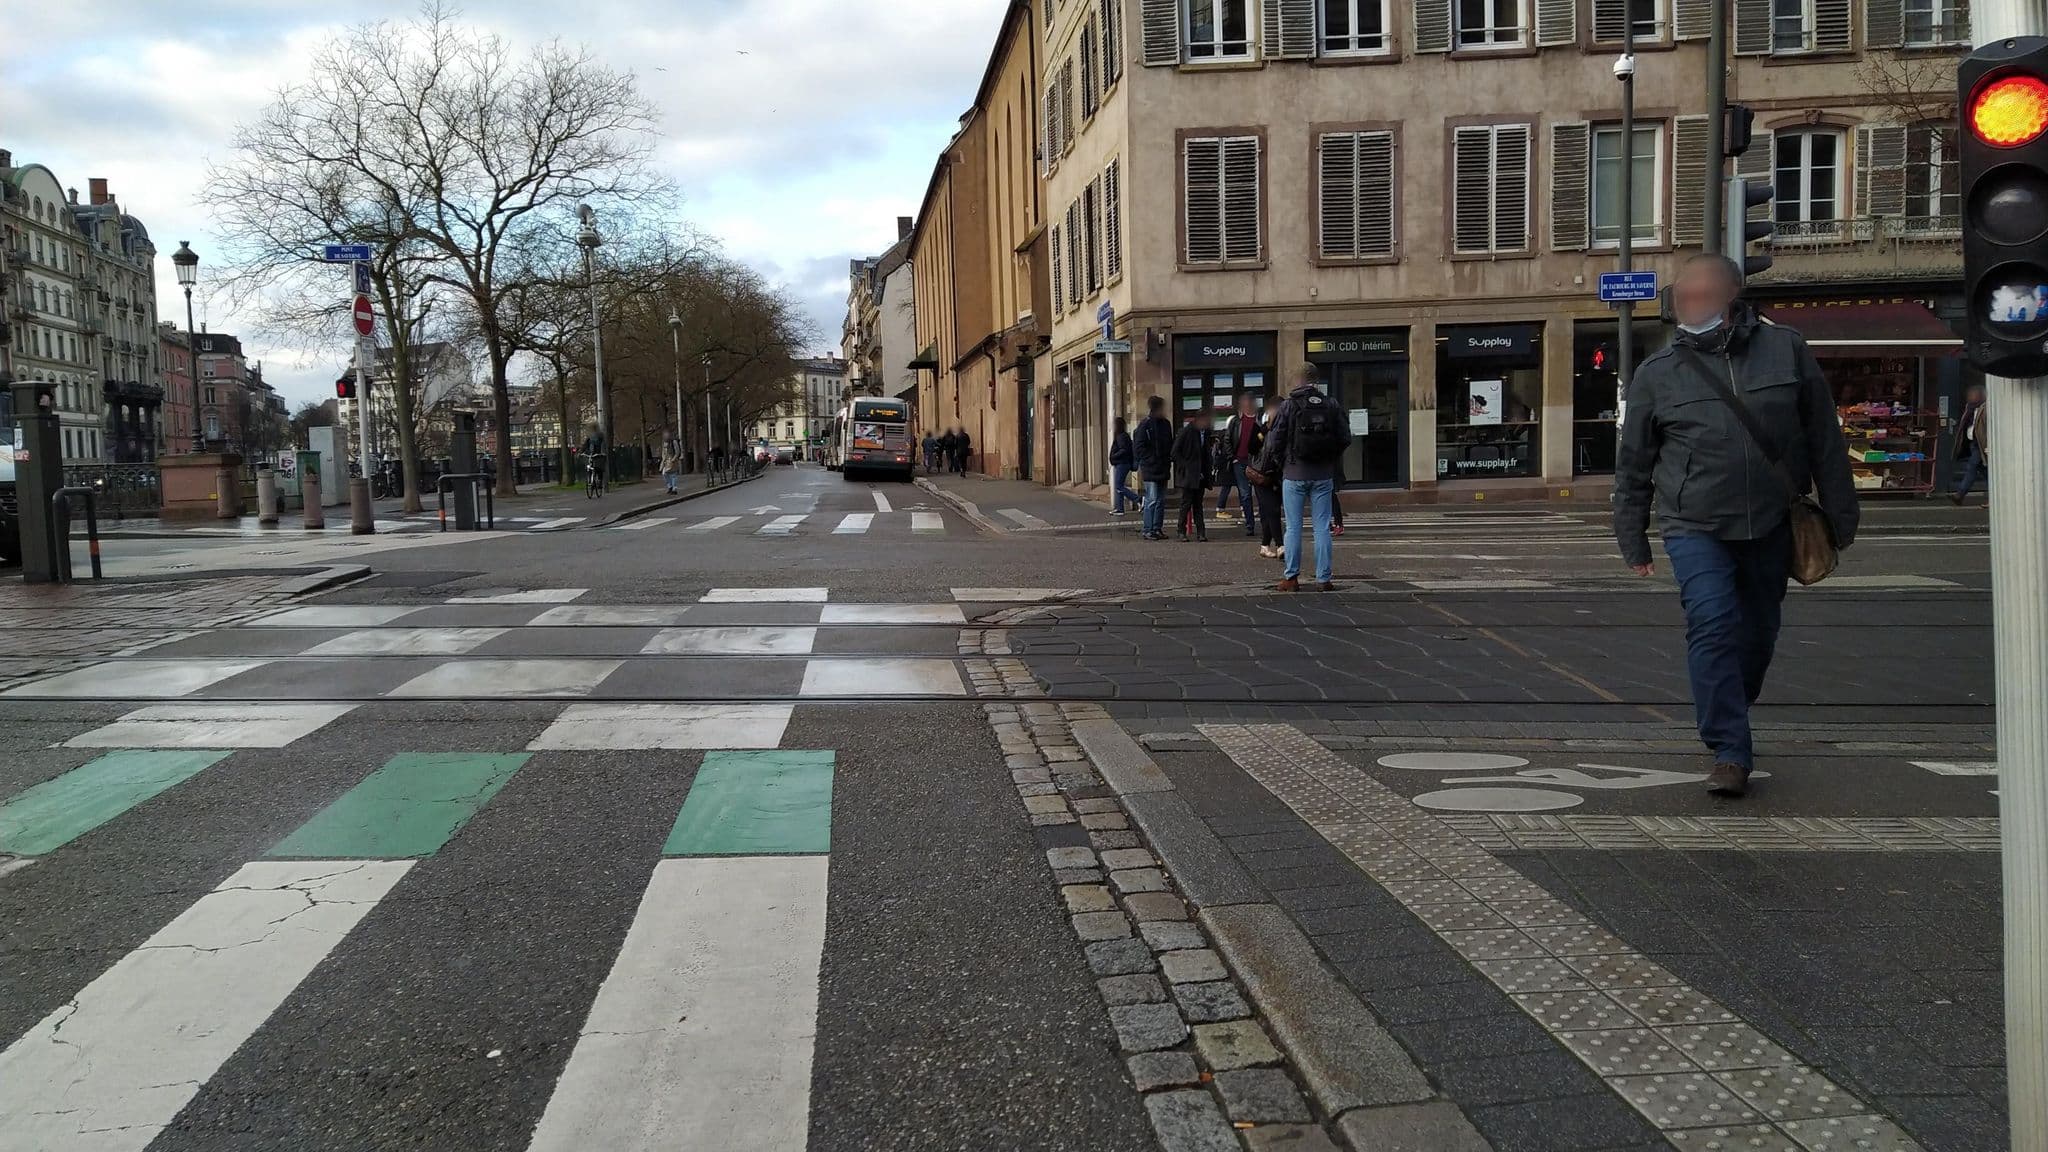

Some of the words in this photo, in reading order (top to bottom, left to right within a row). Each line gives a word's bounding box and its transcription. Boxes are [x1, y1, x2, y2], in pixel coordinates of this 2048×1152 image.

[1340, 342, 1358, 352] CDD
[1362, 341, 1390, 350] Intérim
[1468, 337, 1512, 348] Supplay
[1203, 346, 1246, 356] Supplay
[1456, 458, 1517, 468] www.supplay.fr
